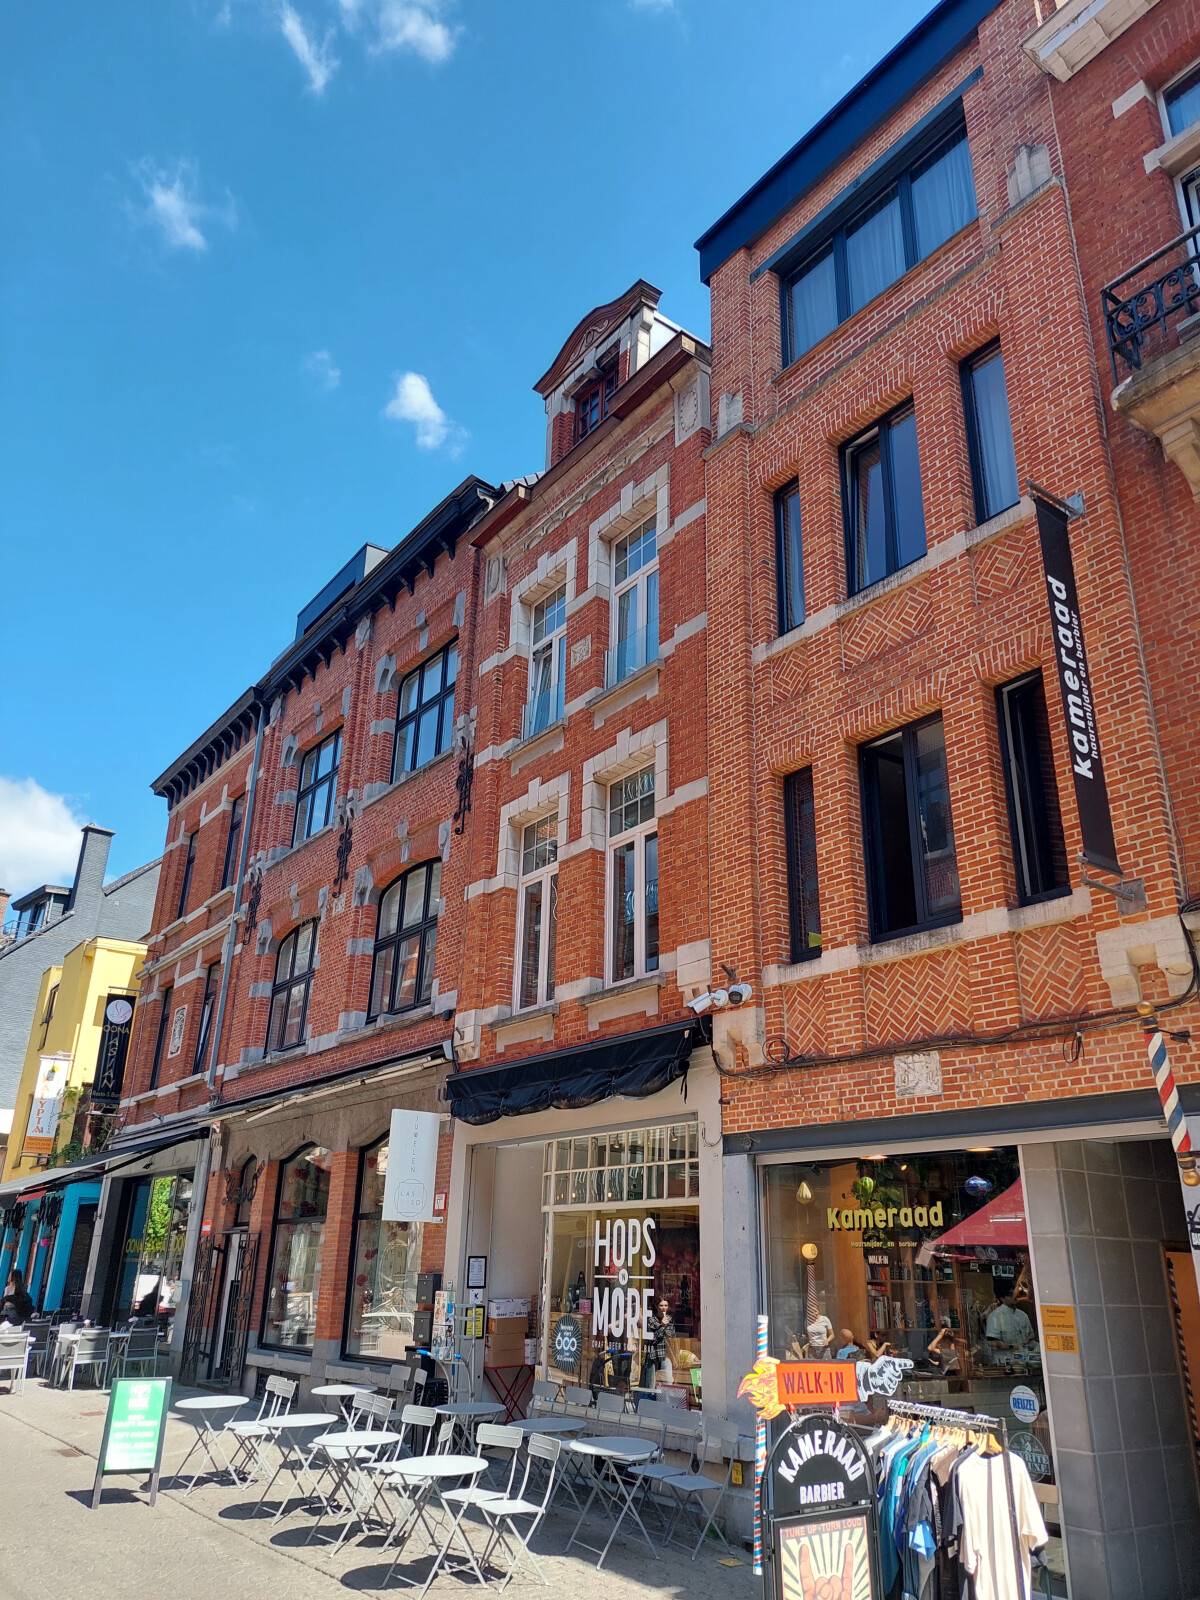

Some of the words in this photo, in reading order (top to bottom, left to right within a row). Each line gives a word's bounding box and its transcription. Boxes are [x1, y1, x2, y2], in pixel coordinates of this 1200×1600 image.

[1070, 610, 1083, 659] barbier
[1047, 574, 1094, 780] kameraad
[1078, 662, 1087, 678] en
[1081, 679, 1098, 759] haarsnijder
[103, 1024, 130, 1034] OONA
[594, 1217, 656, 1267] HOPS
[592, 1287, 655, 1340] MORE
[1012, 1397, 1037, 1412] REUZEL
[777, 1429, 867, 1484] KAMERAAD
[799, 1481, 846, 1505] BARBIER
